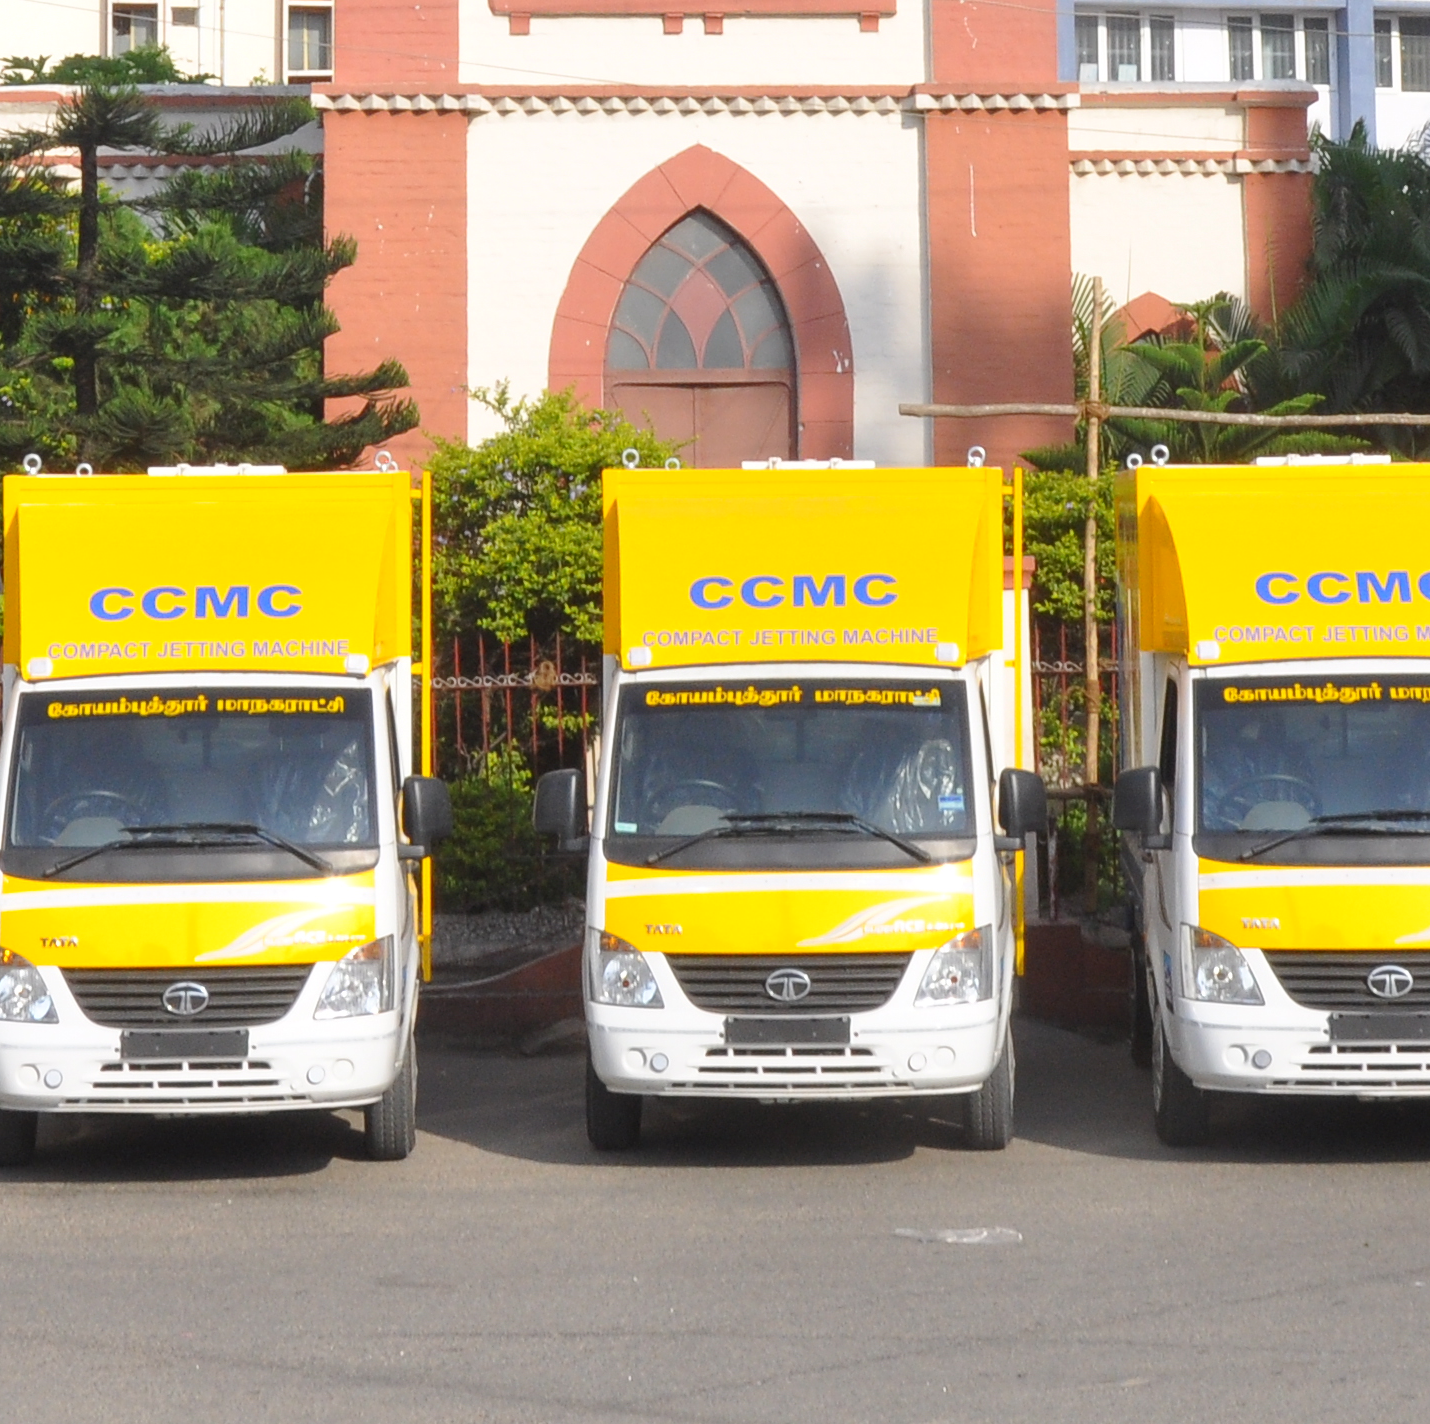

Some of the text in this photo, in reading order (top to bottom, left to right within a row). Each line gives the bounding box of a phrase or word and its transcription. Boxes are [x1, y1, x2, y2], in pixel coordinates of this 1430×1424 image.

[689, 574, 899, 610] CCMC
[88, 585, 303, 621] CCMC
[642, 627, 939, 647] COMPACT JETTING MACHINE
[1213, 625, 1316, 643] COMPACT
[1322, 624, 1410, 642] JETTING
[47, 639, 350, 660] COMPACT JETTING MACHINE
[645, 923, 683, 936] TATA
[1241, 916, 1281, 930] TATA
[40, 936, 79, 949] TATA
